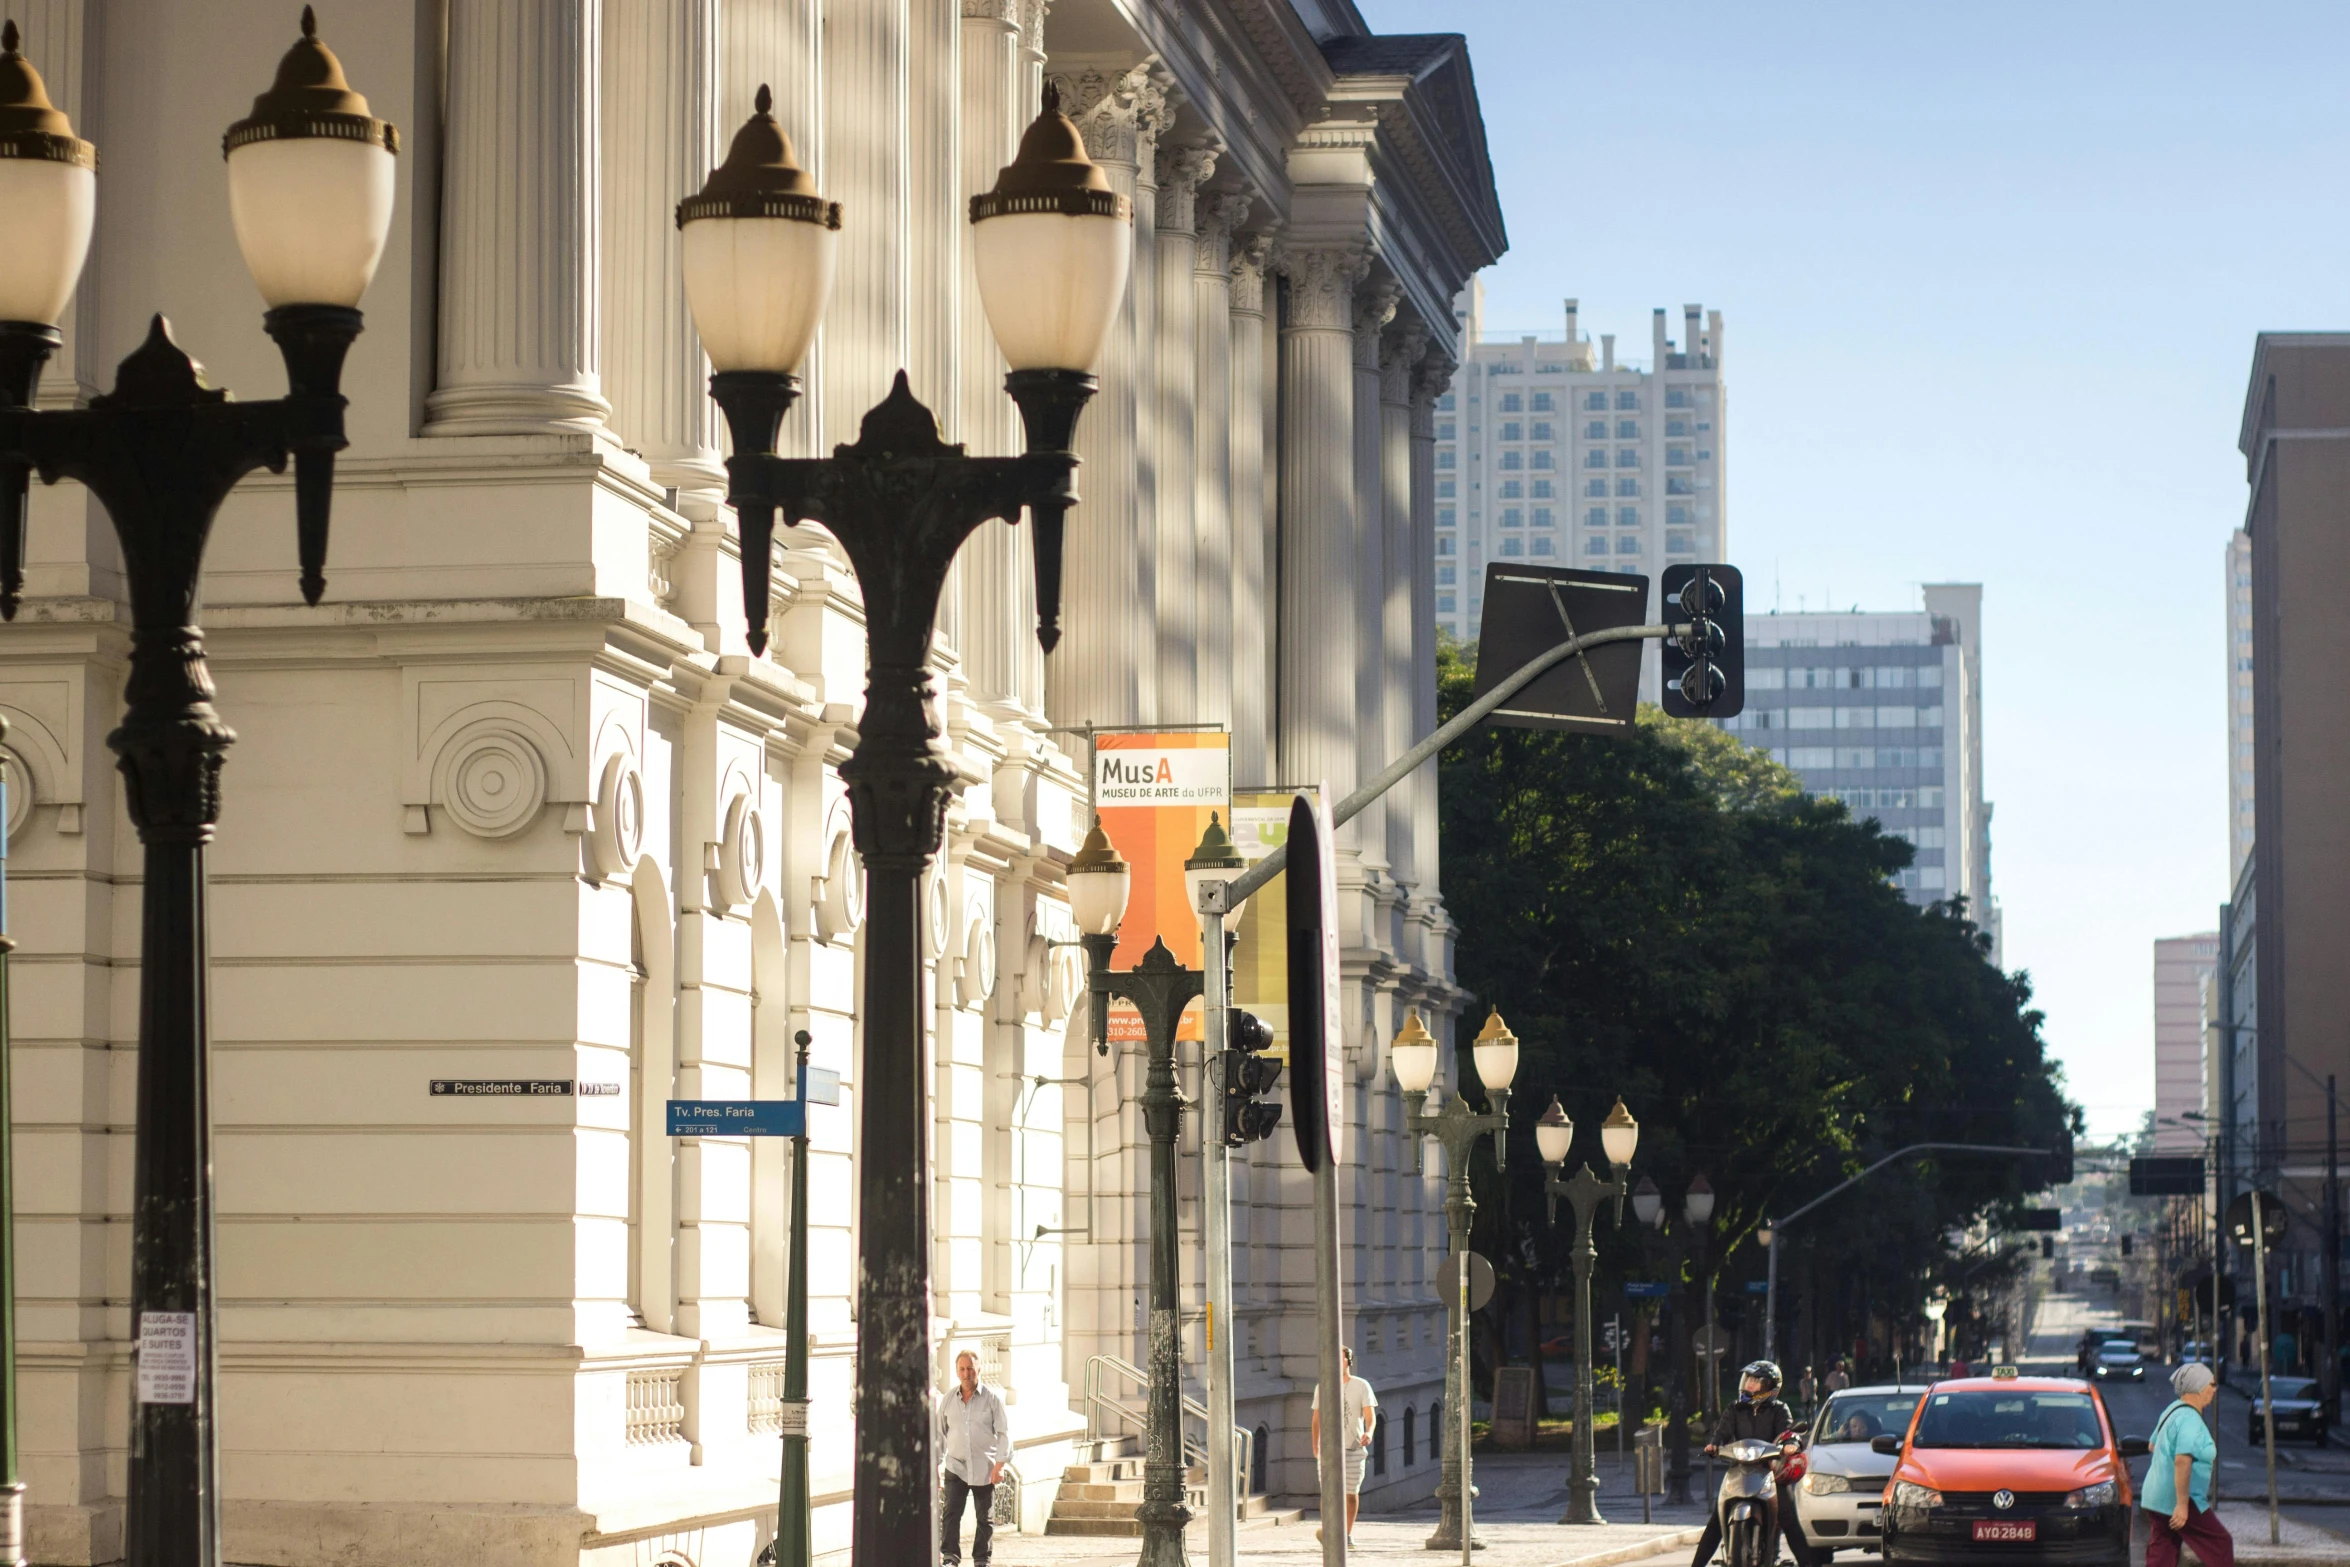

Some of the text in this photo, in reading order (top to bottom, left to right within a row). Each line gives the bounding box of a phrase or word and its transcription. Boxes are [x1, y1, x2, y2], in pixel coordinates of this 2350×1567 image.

[1102, 757, 1173, 784] MusA
[1102, 787, 1223, 798] MUSEU DE ARTE da UFPR
[454, 1082, 562, 1094] Presidente Faria
[674, 1107, 755, 1117] Tv. Pres. Faria
[142, 1315, 189, 1324] ALUGA-SE
[143, 1327, 186, 1337] QUARTOS
[148, 1340, 182, 1349] SUITES
[1996, 1367, 2015, 1376] TAXI
